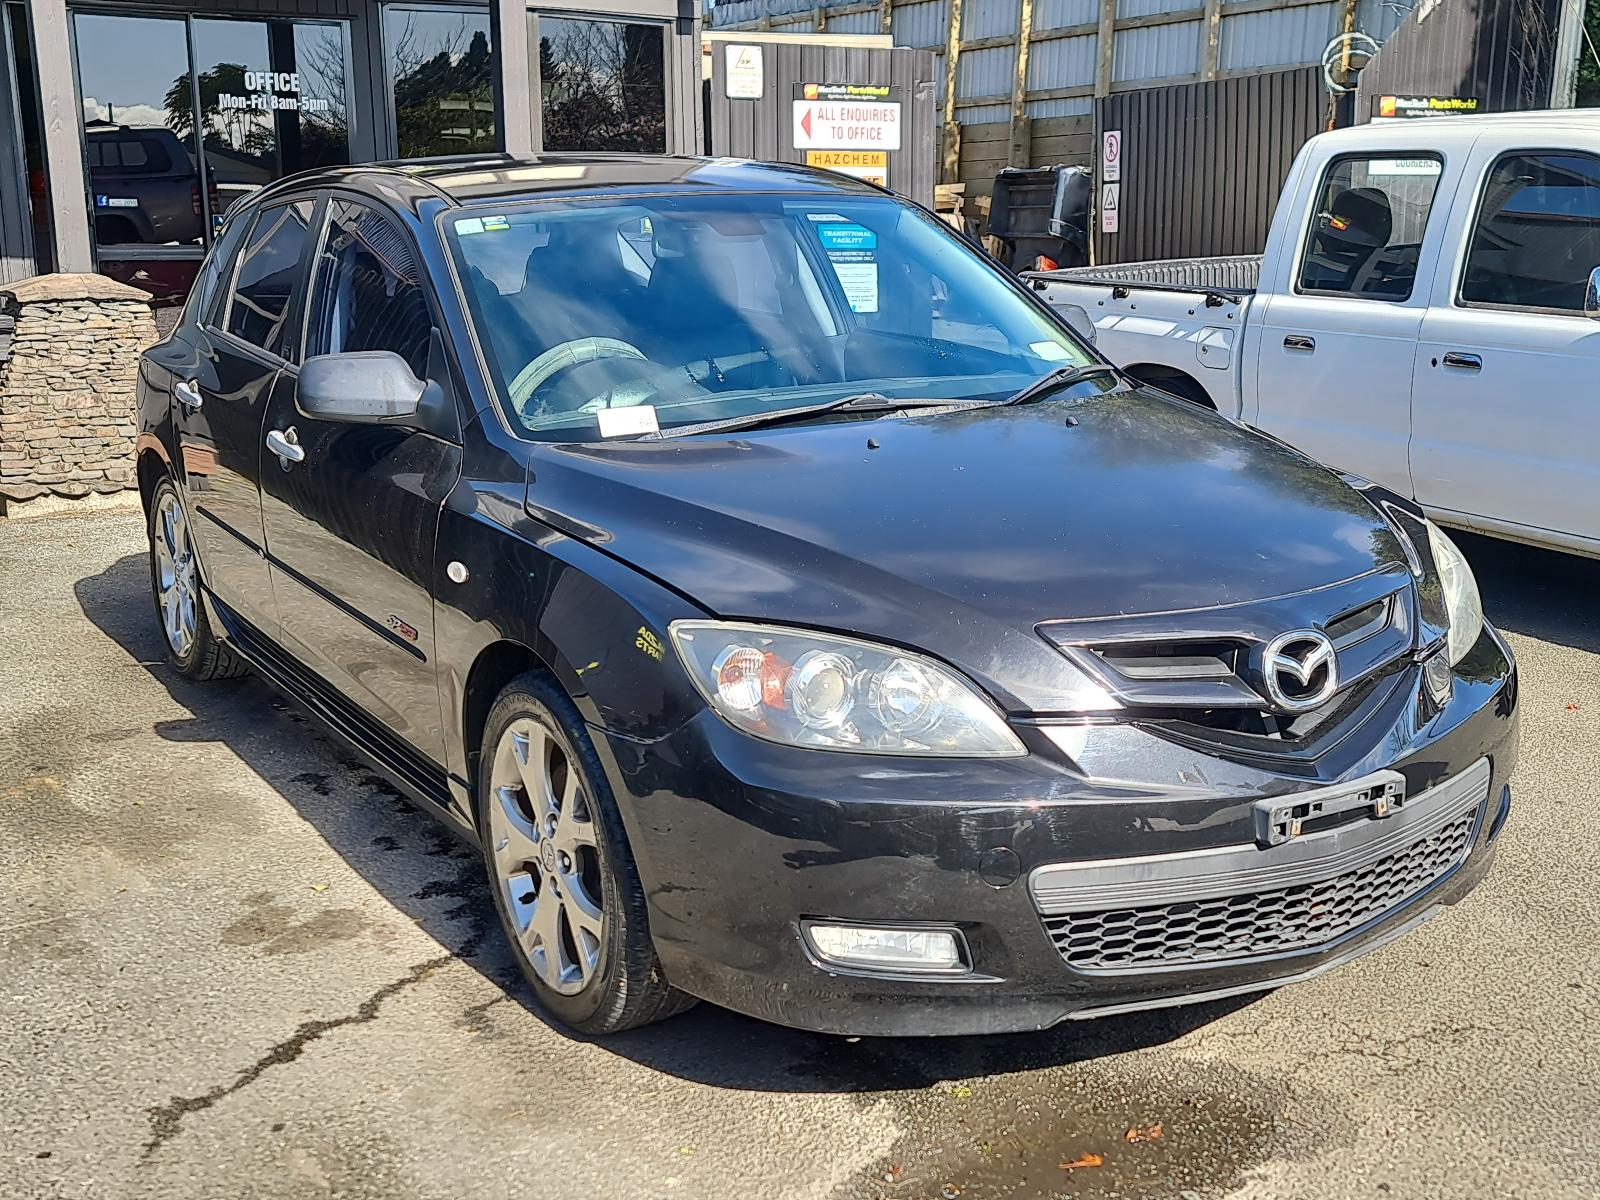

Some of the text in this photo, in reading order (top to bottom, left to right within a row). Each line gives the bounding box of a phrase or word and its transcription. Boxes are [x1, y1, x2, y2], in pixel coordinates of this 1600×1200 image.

[244, 71, 301, 92] OFFICE
[218, 93, 329, 112] Mon-Fri 8am-5pm
[817, 107, 896, 122] ALL ENQUIRIES
[831, 126, 882, 140] TO OFFICE
[814, 153, 880, 165] HAZCHEM
